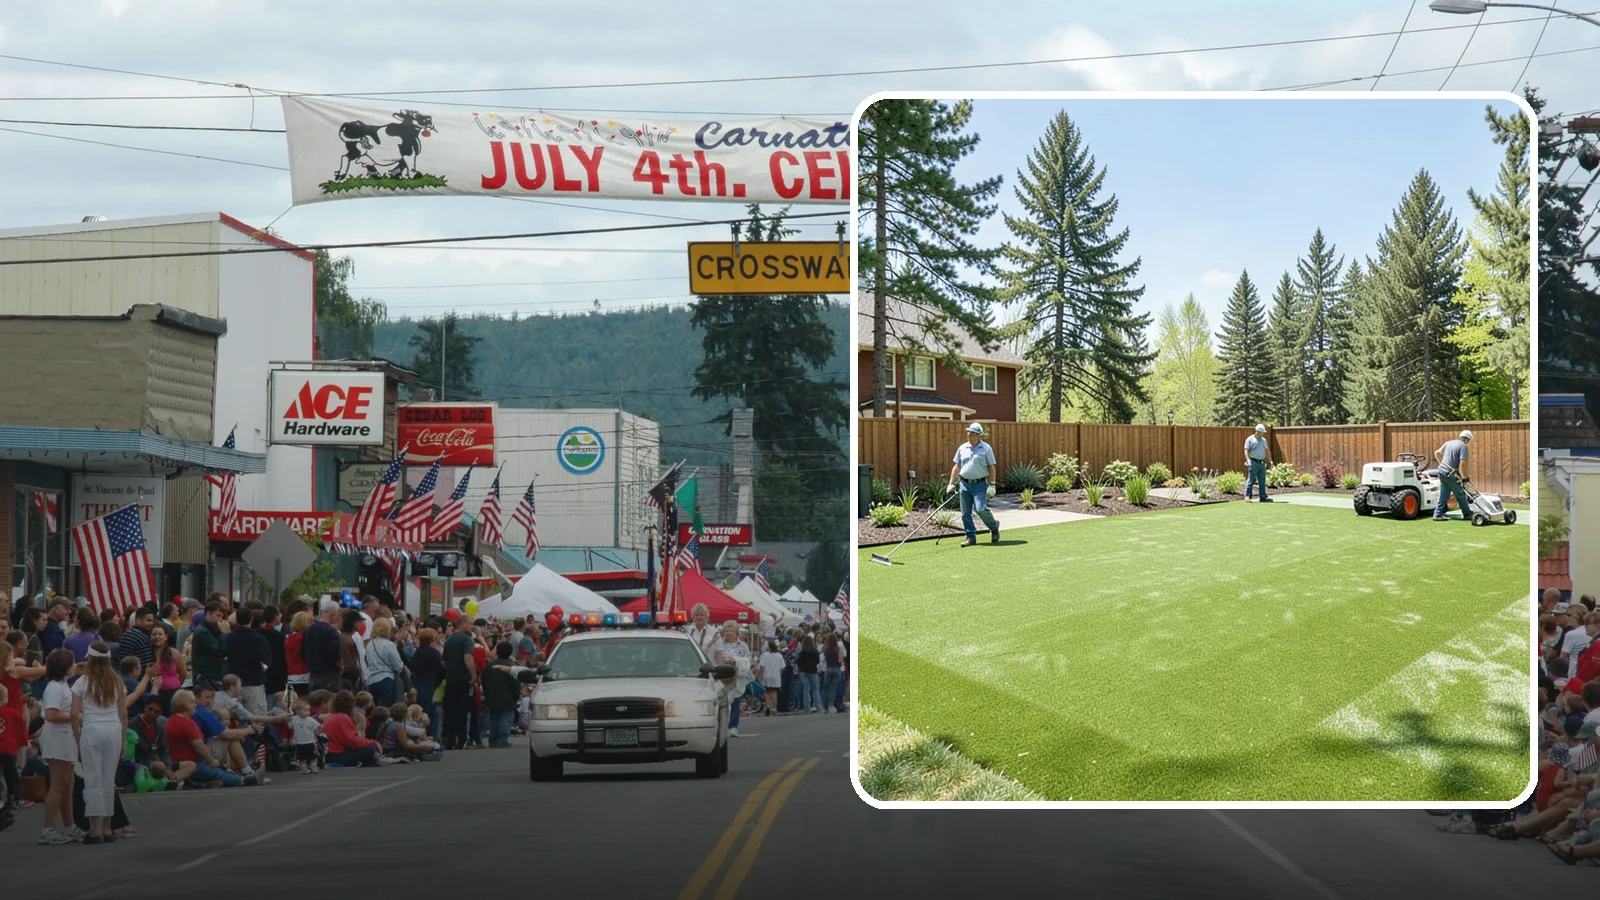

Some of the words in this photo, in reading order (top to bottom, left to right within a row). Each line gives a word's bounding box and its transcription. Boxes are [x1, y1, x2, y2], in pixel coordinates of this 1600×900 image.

[694, 121, 850, 151] Carnat
[481, 141, 605, 192] JULY
[632, 149, 746, 198] 4th.
[697, 254, 850, 280] CROSSWA
[283, 380, 373, 420] ACE
[406, 409, 452, 421] CEDAR
[461, 409, 485, 421] LOG
[284, 421, 371, 436] Hardware
[416, 428, 477, 446] Coca-Cola
[83, 485, 93, 494] St.
[95, 485, 124, 494] Vincent
[126, 486, 135, 495] de
[138, 486, 155, 495] Paul
[699, 535, 730, 543] GLASS
